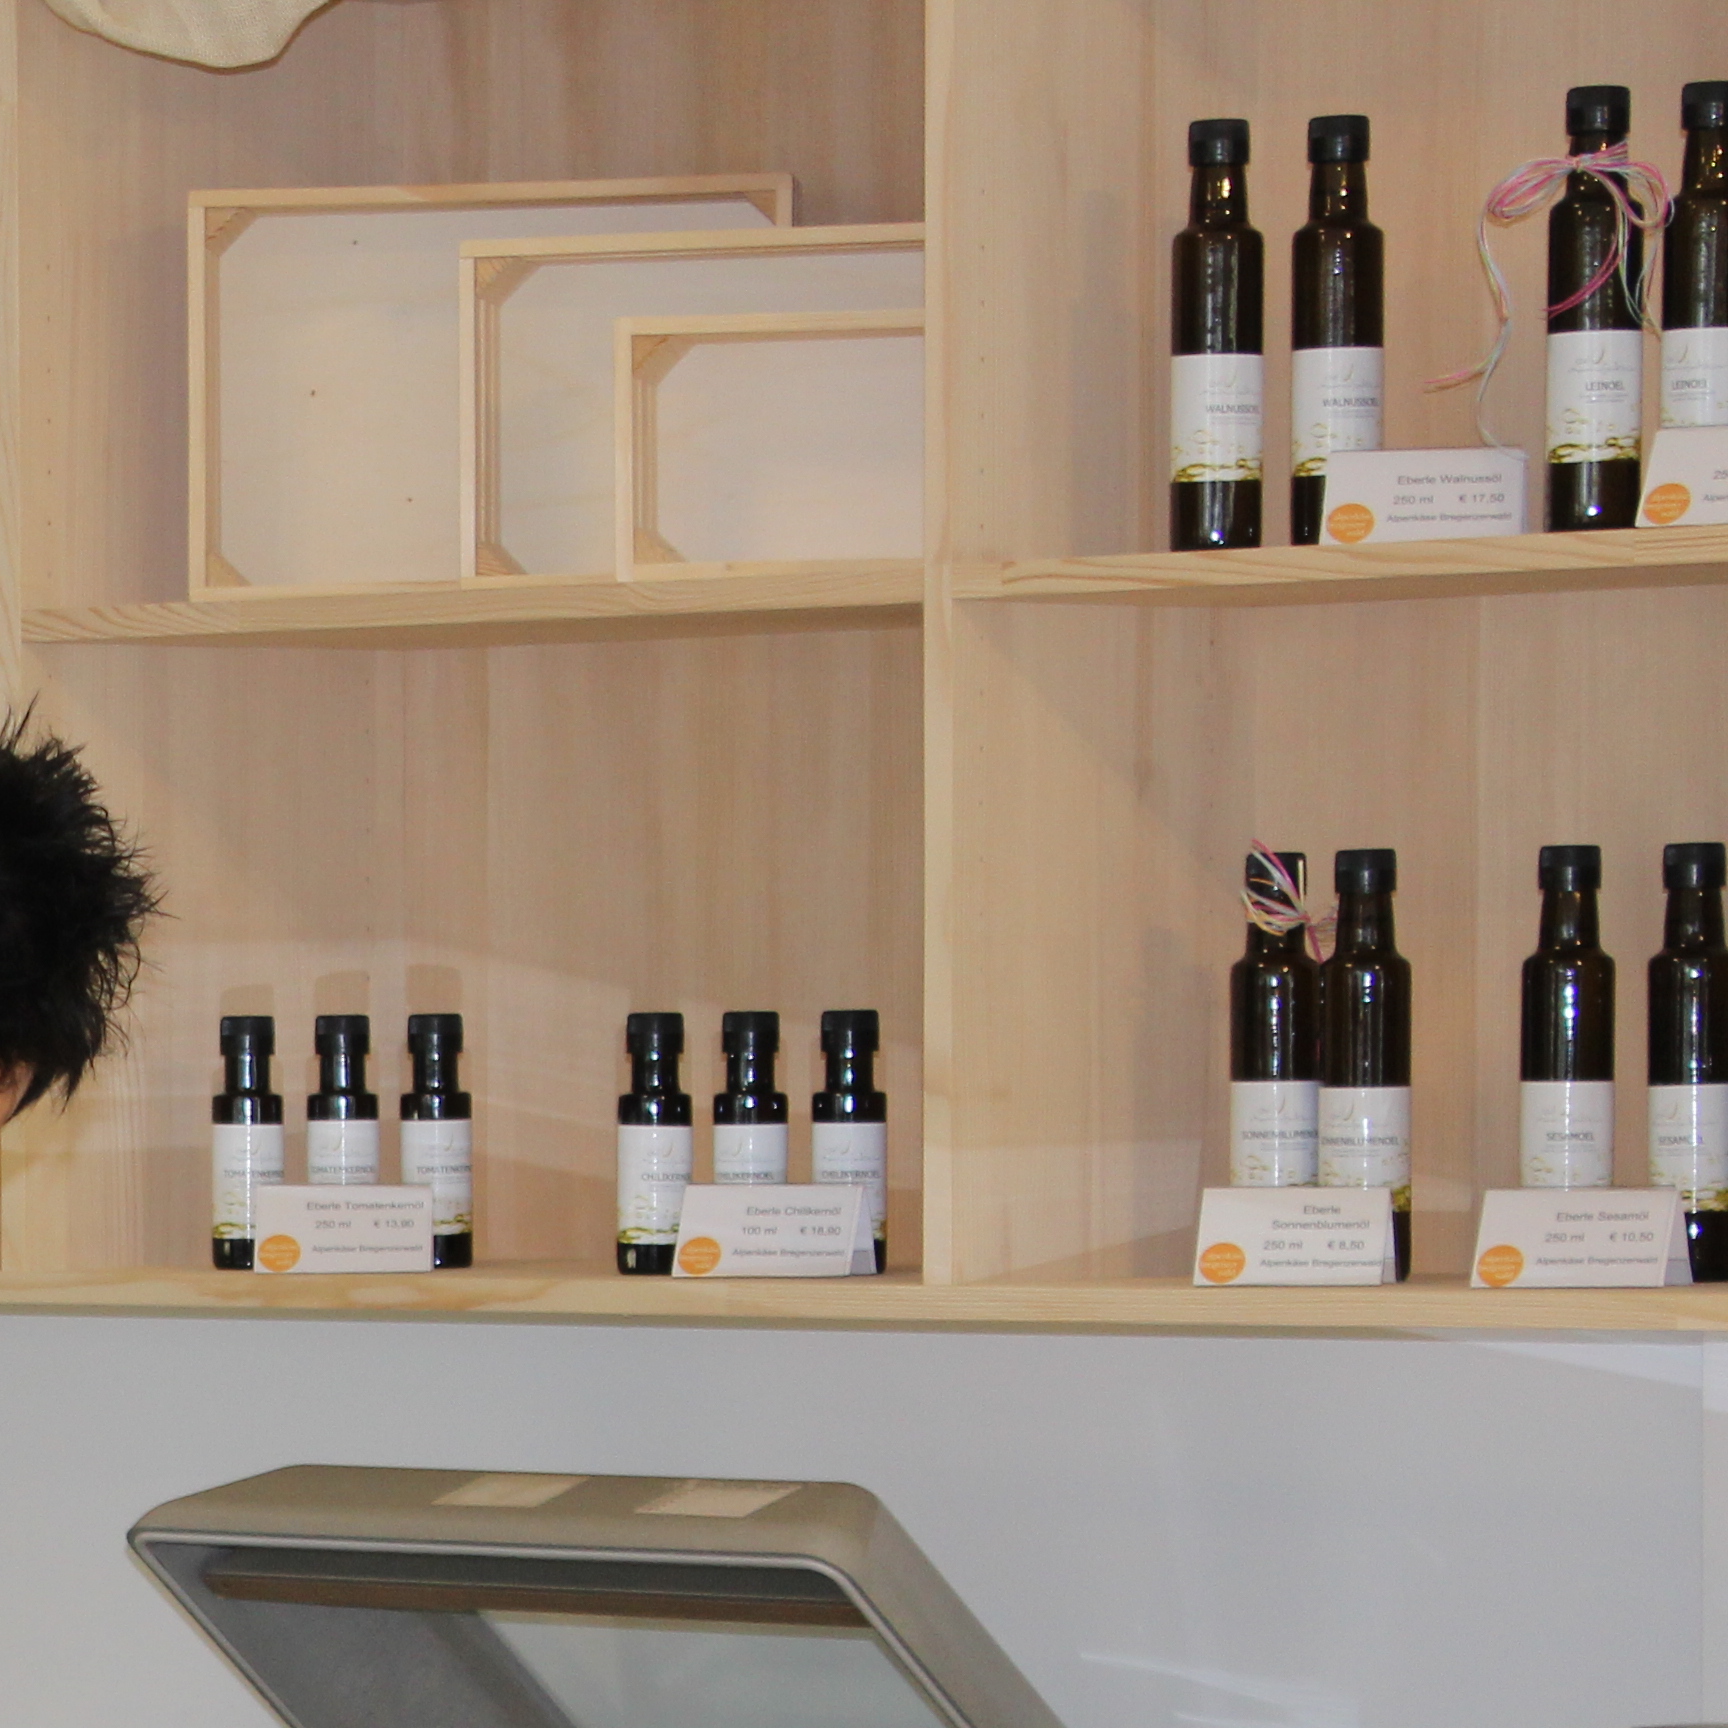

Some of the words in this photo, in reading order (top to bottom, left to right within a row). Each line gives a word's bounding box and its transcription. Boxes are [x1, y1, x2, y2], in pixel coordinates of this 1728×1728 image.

[1397, 475, 1436, 486] Eberle
[1393, 495, 1415, 505] 250
[1419, 495, 1434, 504] ml
[306, 1201, 341, 1211] Eberle
[746, 1206, 780, 1216] Eberle
[1303, 1205, 1341, 1215] Eberle
[1556, 1211, 1593, 1222] Eberle
[315, 1220, 335, 1230] 250
[1272, 1220, 1370, 1230] Sonnenblumenöl
[742, 1226, 761, 1236] 100
[1544, 1233, 1567, 1243] 250
[1570, 1232, 1585, 1242] ml
[1263, 1240, 1285, 1250] 250
[1288, 1240, 1303, 1249] ml
